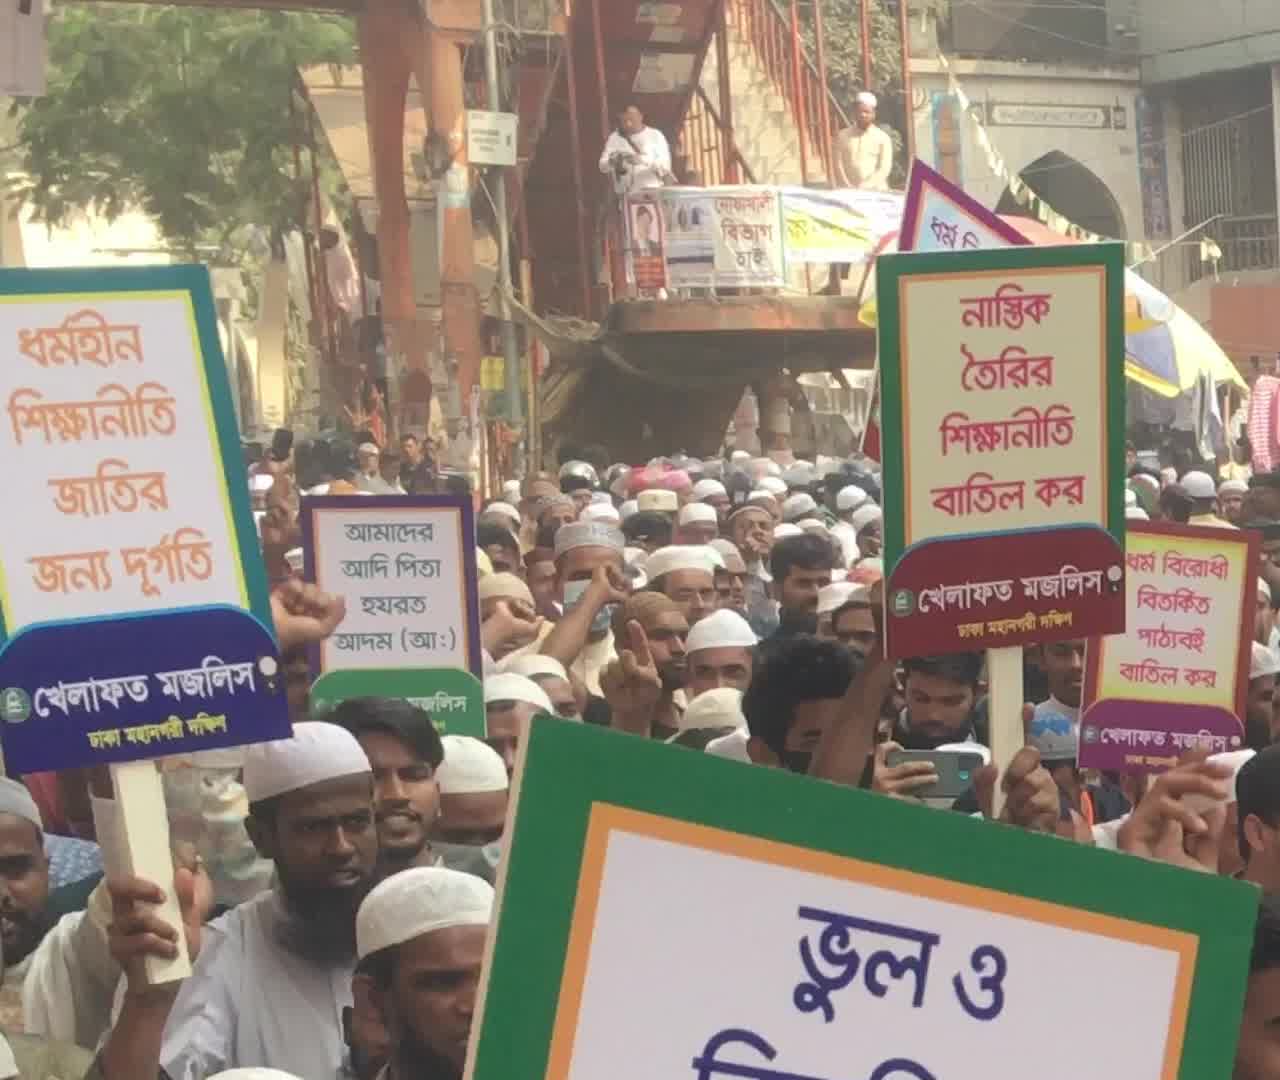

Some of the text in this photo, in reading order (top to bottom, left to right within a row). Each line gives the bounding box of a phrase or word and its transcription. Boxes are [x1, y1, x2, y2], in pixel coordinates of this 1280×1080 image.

[960, 283, 1053, 330] নাস্তিক
[17, 309, 144, 367] ধর্মহীন
[960, 343, 1054, 391] তৈরির
[8, 381, 177, 445] শিক্ষানীতি
[939, 404, 1075, 456] শিক্ষানীতি
[48, 459, 170, 517] জাতির
[930, 471, 1086, 517] বাতিল কর
[344, 522, 435, 543] আমাদের
[28, 550, 113, 594] জন্য
[341, 552, 441, 579] আদি পিতা
[1162, 550, 1229, 581] বিরোধী
[361, 594, 428, 617] হযরত
[918, 565, 1103, 613] খেলাফত মজলিস
[333, 631, 393, 652] আদম
[1137, 621, 1205, 654] পাঠ্যবই
[33, 656, 257, 718] খেলাফত মজলিস
[1119, 658, 1218, 689] বাতিল কর
[1100, 728, 1167, 747] খেলাফত
[793, 905, 1008, 1023] ভুল ও
